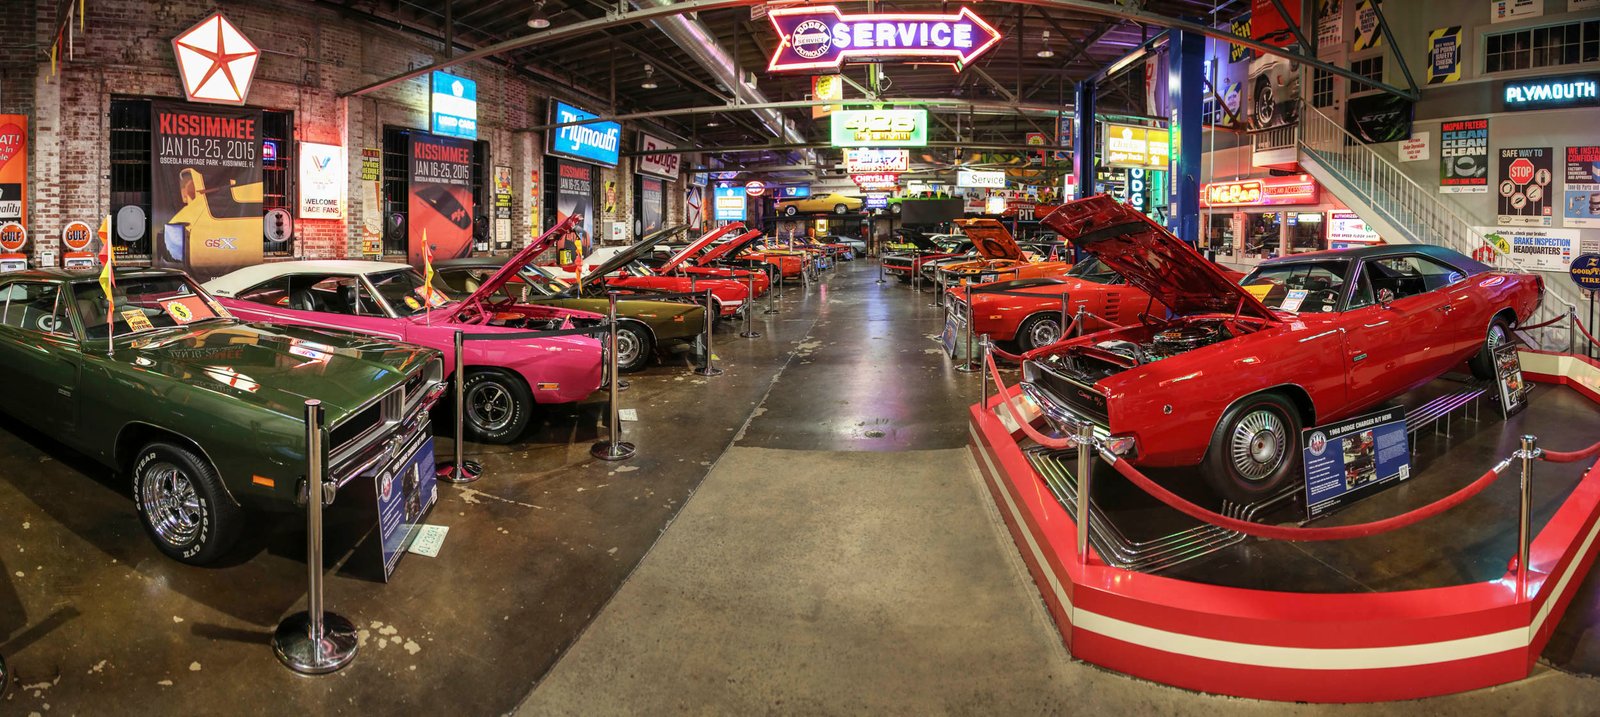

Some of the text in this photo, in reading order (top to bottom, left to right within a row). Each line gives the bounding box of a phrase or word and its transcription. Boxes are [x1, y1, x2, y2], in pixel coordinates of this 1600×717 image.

[797, 22, 826, 35] DODGE
[832, 22, 972, 48] SERVICE
[796, 44, 828, 57] PLYMOUTH
[1436, 58, 1452, 66] CHECK
[1506, 82, 1596, 102] PLYMOUTH
[1358, 111, 1401, 123] SRT
[160, 113, 255, 140] KISSIMMEE
[458, 118, 476, 130] CARS
[1443, 120, 1487, 131] MOPAR FILTERS
[560, 110, 618, 152] Plymouth
[1443, 129, 1487, 140] CLEAN
[160, 137, 183, 157] JAN
[187, 138, 227, 161] 16-25,
[228, 140, 255, 160] 2015
[1442, 138, 1486, 148] CLEAN
[414, 142, 469, 166] KISSIMMEE
[646, 142, 677, 173] Dodge
[1442, 147, 1486, 157] CLEAN
[415, 160, 469, 179] JAN 16-25, 2015
[560, 164, 590, 181] KISSIMMEE
[1512, 166, 1532, 178] STOP
[972, 175, 1003, 184] Service
[1131, 168, 1144, 210] ODG
[0, 202, 20, 216] ality
[1019, 210, 1034, 220] PIT
[1, 232, 21, 242] GULF
[68, 230, 87, 241] GULF
[205, 238, 237, 249] GSX
[1514, 237, 1571, 248] BRAKE INSPECTION
[1514, 246, 1560, 256] HEADQUARTERS
[38, 314, 62, 331] G
[1341, 423, 1355, 433] DODGE
[1356, 418, 1374, 429] CHARGER
[134, 452, 156, 511] GOODYEAR
[200, 498, 208, 543] EAGLE
